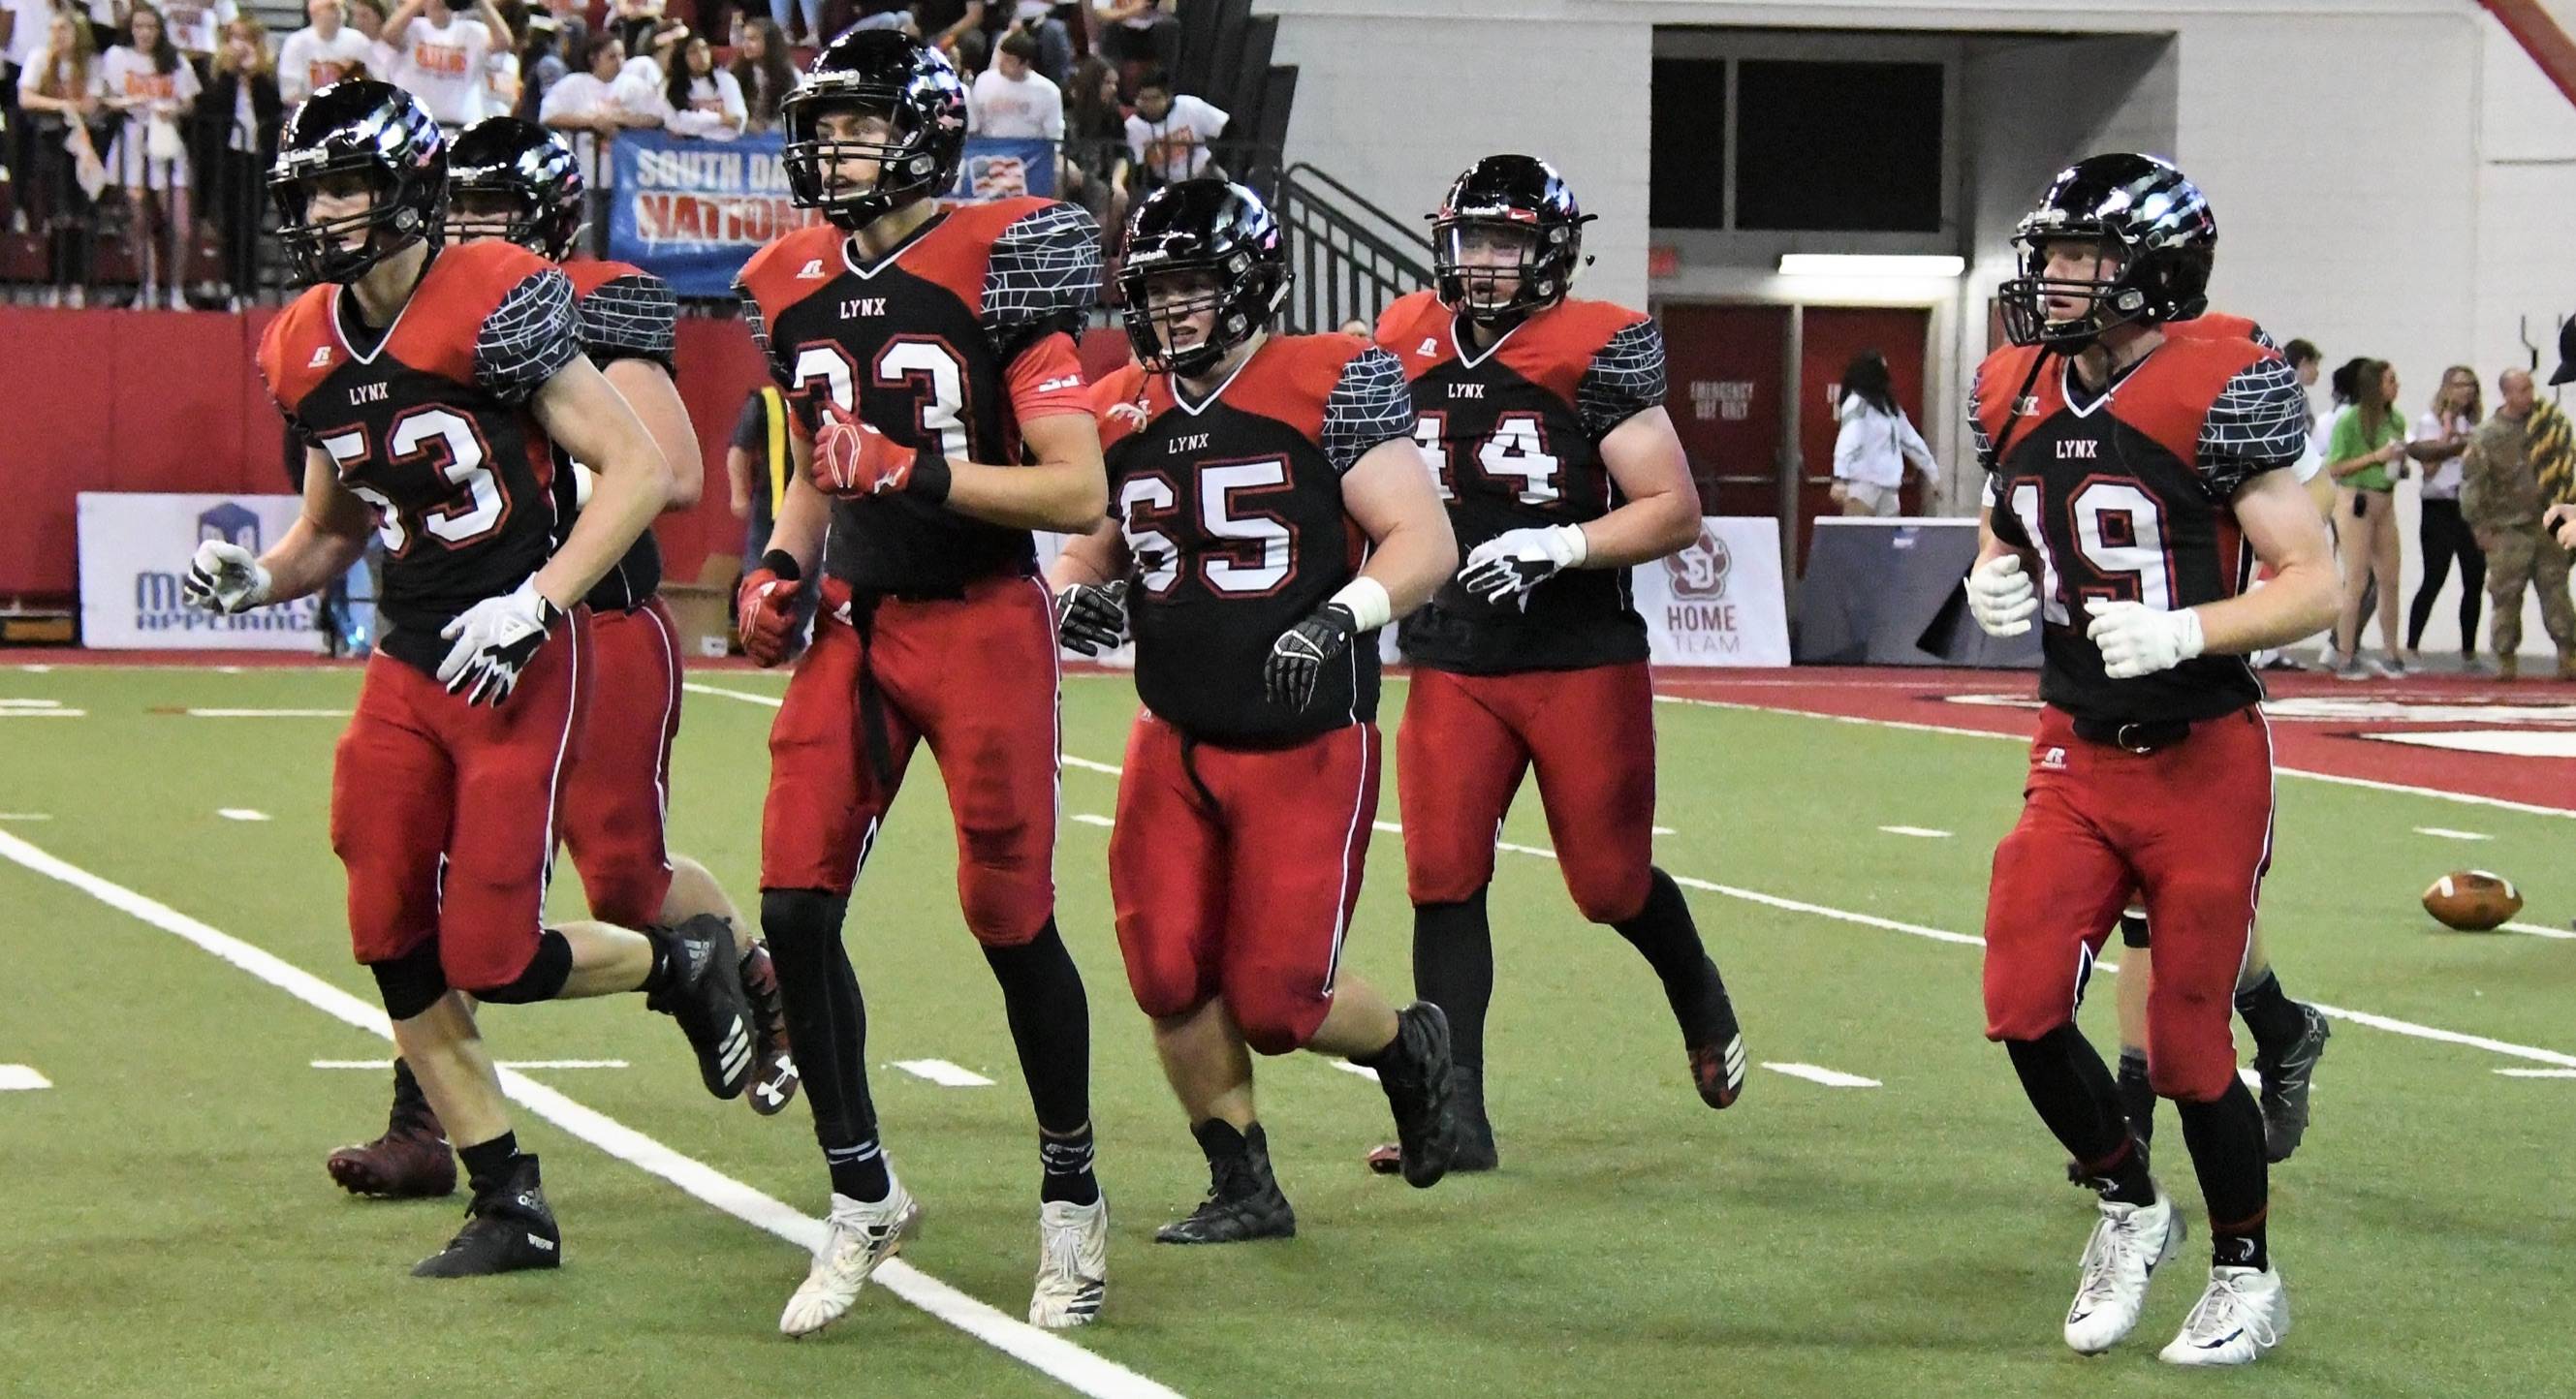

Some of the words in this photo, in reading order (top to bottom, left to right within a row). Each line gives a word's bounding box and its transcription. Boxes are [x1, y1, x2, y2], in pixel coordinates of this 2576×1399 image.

[637, 149, 741, 189] SOUTH
[637, 191, 828, 243] NATION
[839, 296, 886, 320] LYNX
[349, 381, 390, 406] LYNX
[1447, 383, 1485, 399] LYNX
[1168, 432, 1209, 454] LYNX
[2056, 440, 2098, 459] LYNX
[316, 403, 512, 558] 53
[1120, 452, 1300, 600] 65
[2007, 474, 2180, 629] 19
[1667, 605, 1737, 632] HOME
